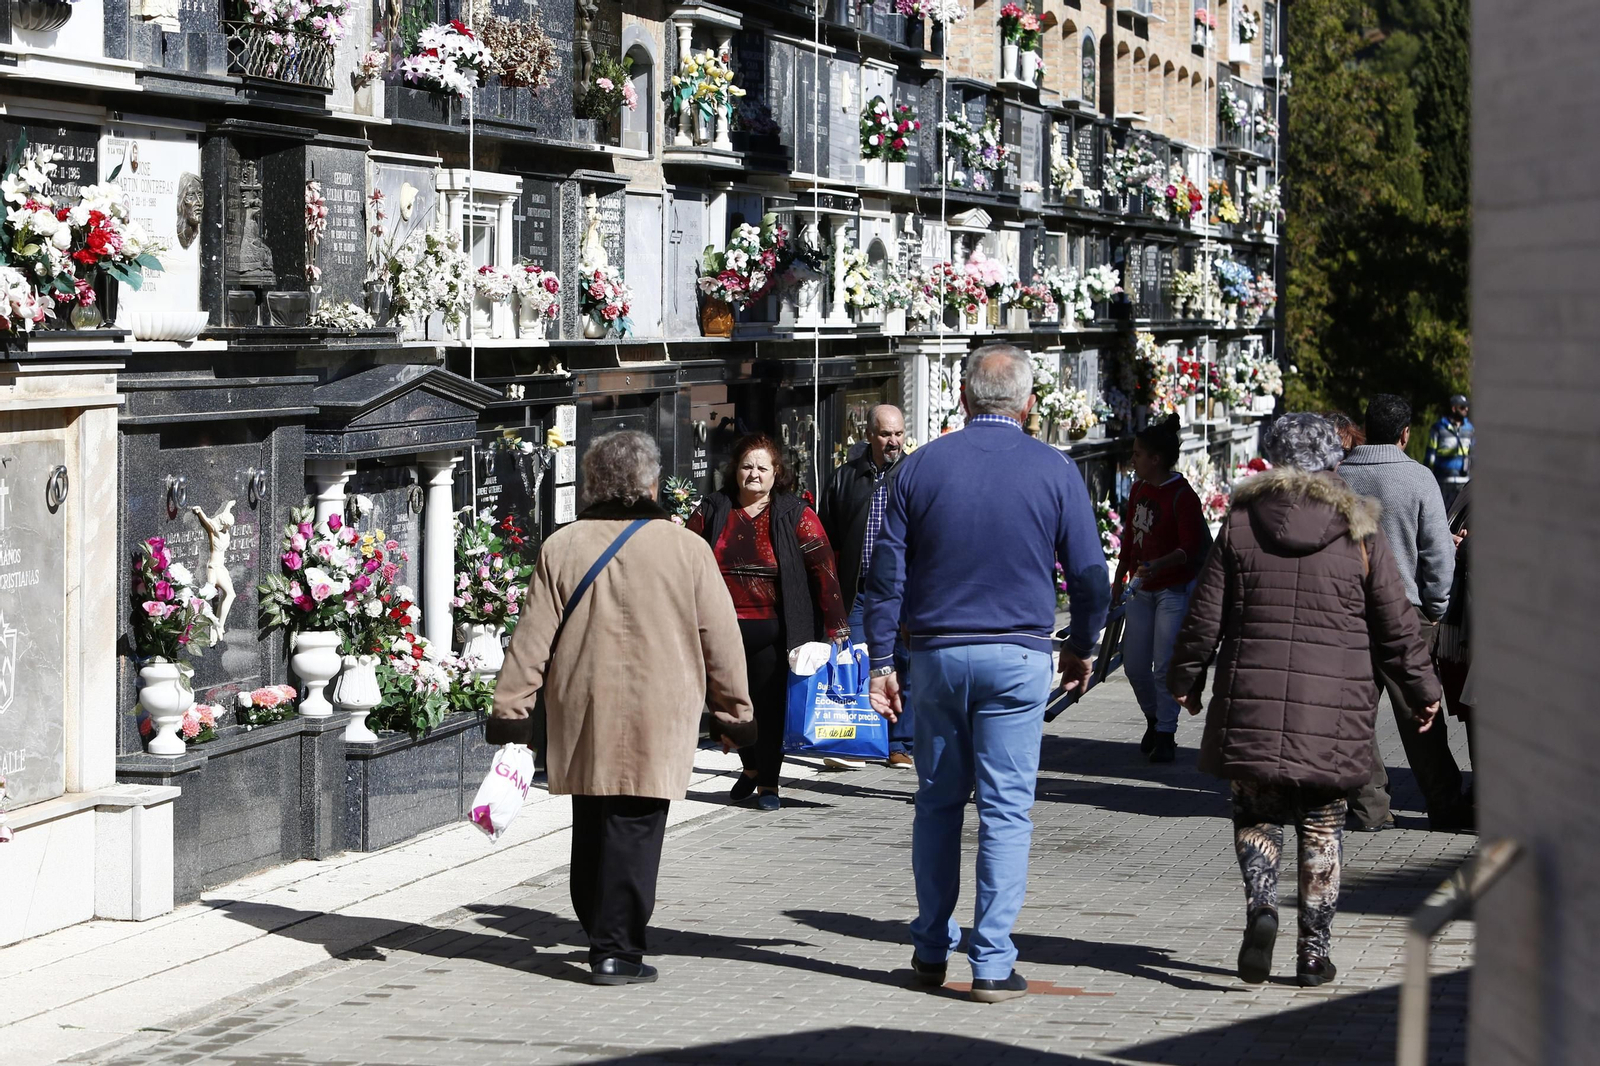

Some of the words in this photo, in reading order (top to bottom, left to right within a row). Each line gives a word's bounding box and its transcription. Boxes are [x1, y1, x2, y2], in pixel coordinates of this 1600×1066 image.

[141, 179, 174, 195] CONTRERAS
[0, 569, 40, 590] CRISTIANAS
[817, 681, 845, 692] Bueo.
[814, 711, 821, 719] Y
[823, 711, 831, 719] al
[833, 711, 857, 722] mejor
[858, 712, 880, 722] precio.
[817, 727, 828, 738] Es
[829, 727, 839, 737] de
[839, 726, 855, 738] Lidl
[0, 748, 26, 776] ALLE
